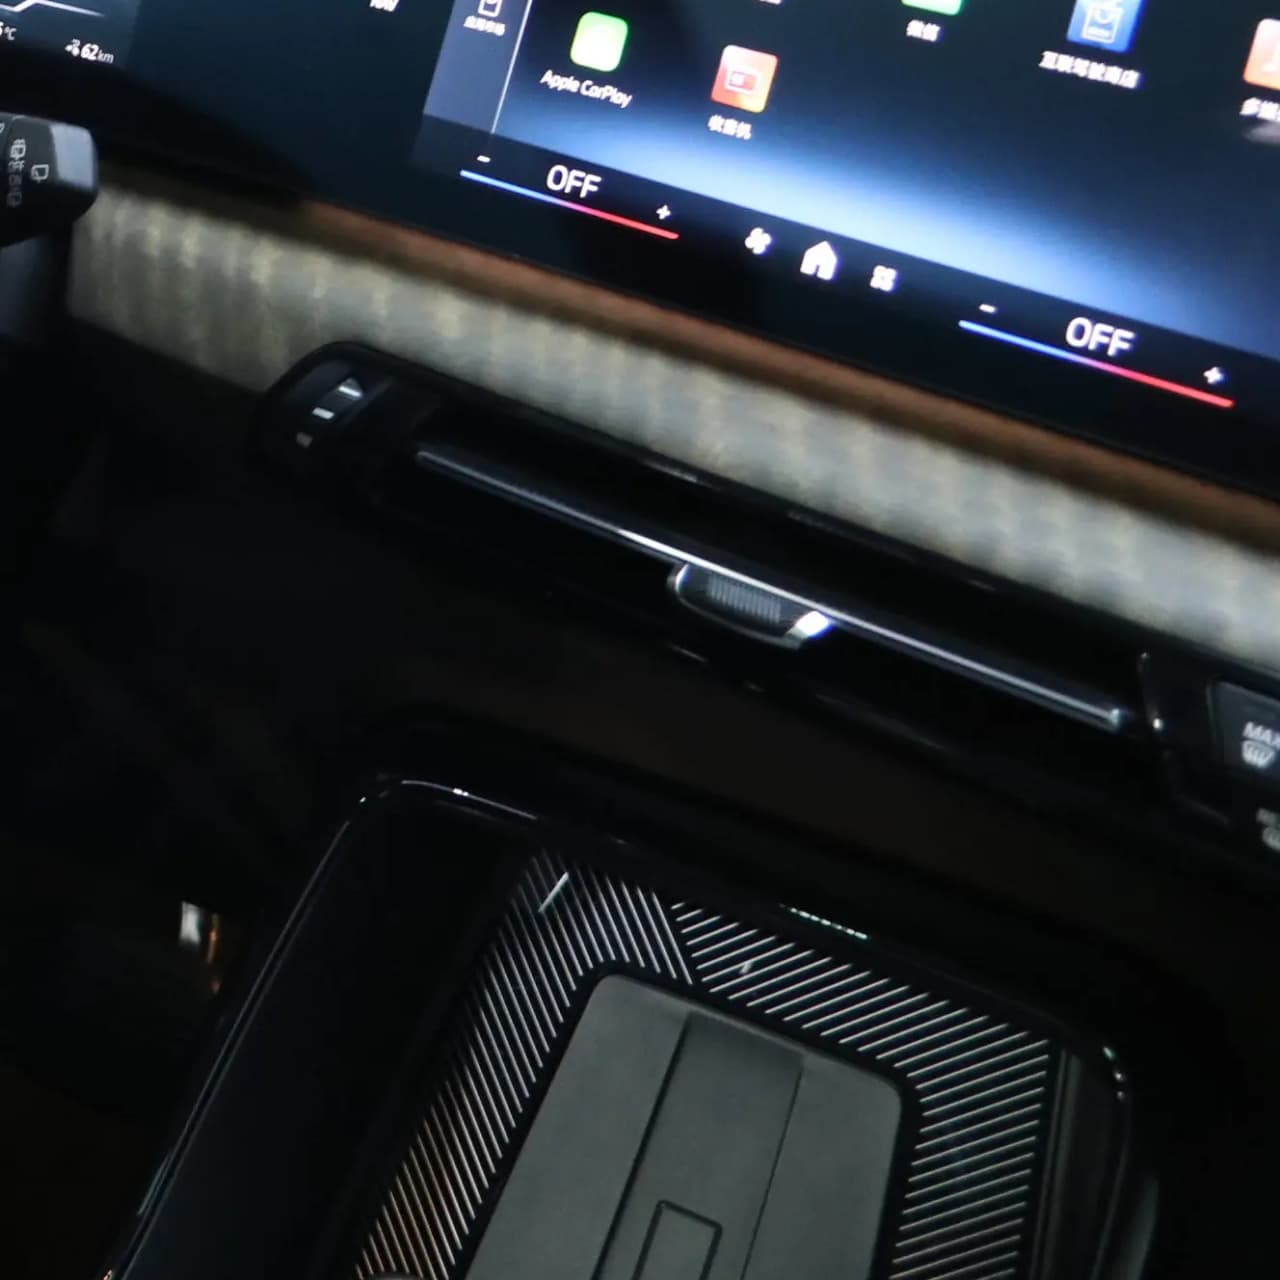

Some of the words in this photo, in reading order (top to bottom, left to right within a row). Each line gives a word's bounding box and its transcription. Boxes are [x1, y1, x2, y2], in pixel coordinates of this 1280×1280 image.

[80, 43, 99, 60] 62
[98, 49, 115, 64] km
[540, 69, 579, 94] Apple
[579, 79, 633, 109] CarPlay
[546, 164, 602, 199] OFF
[1065, 316, 1137, 357] OFF
